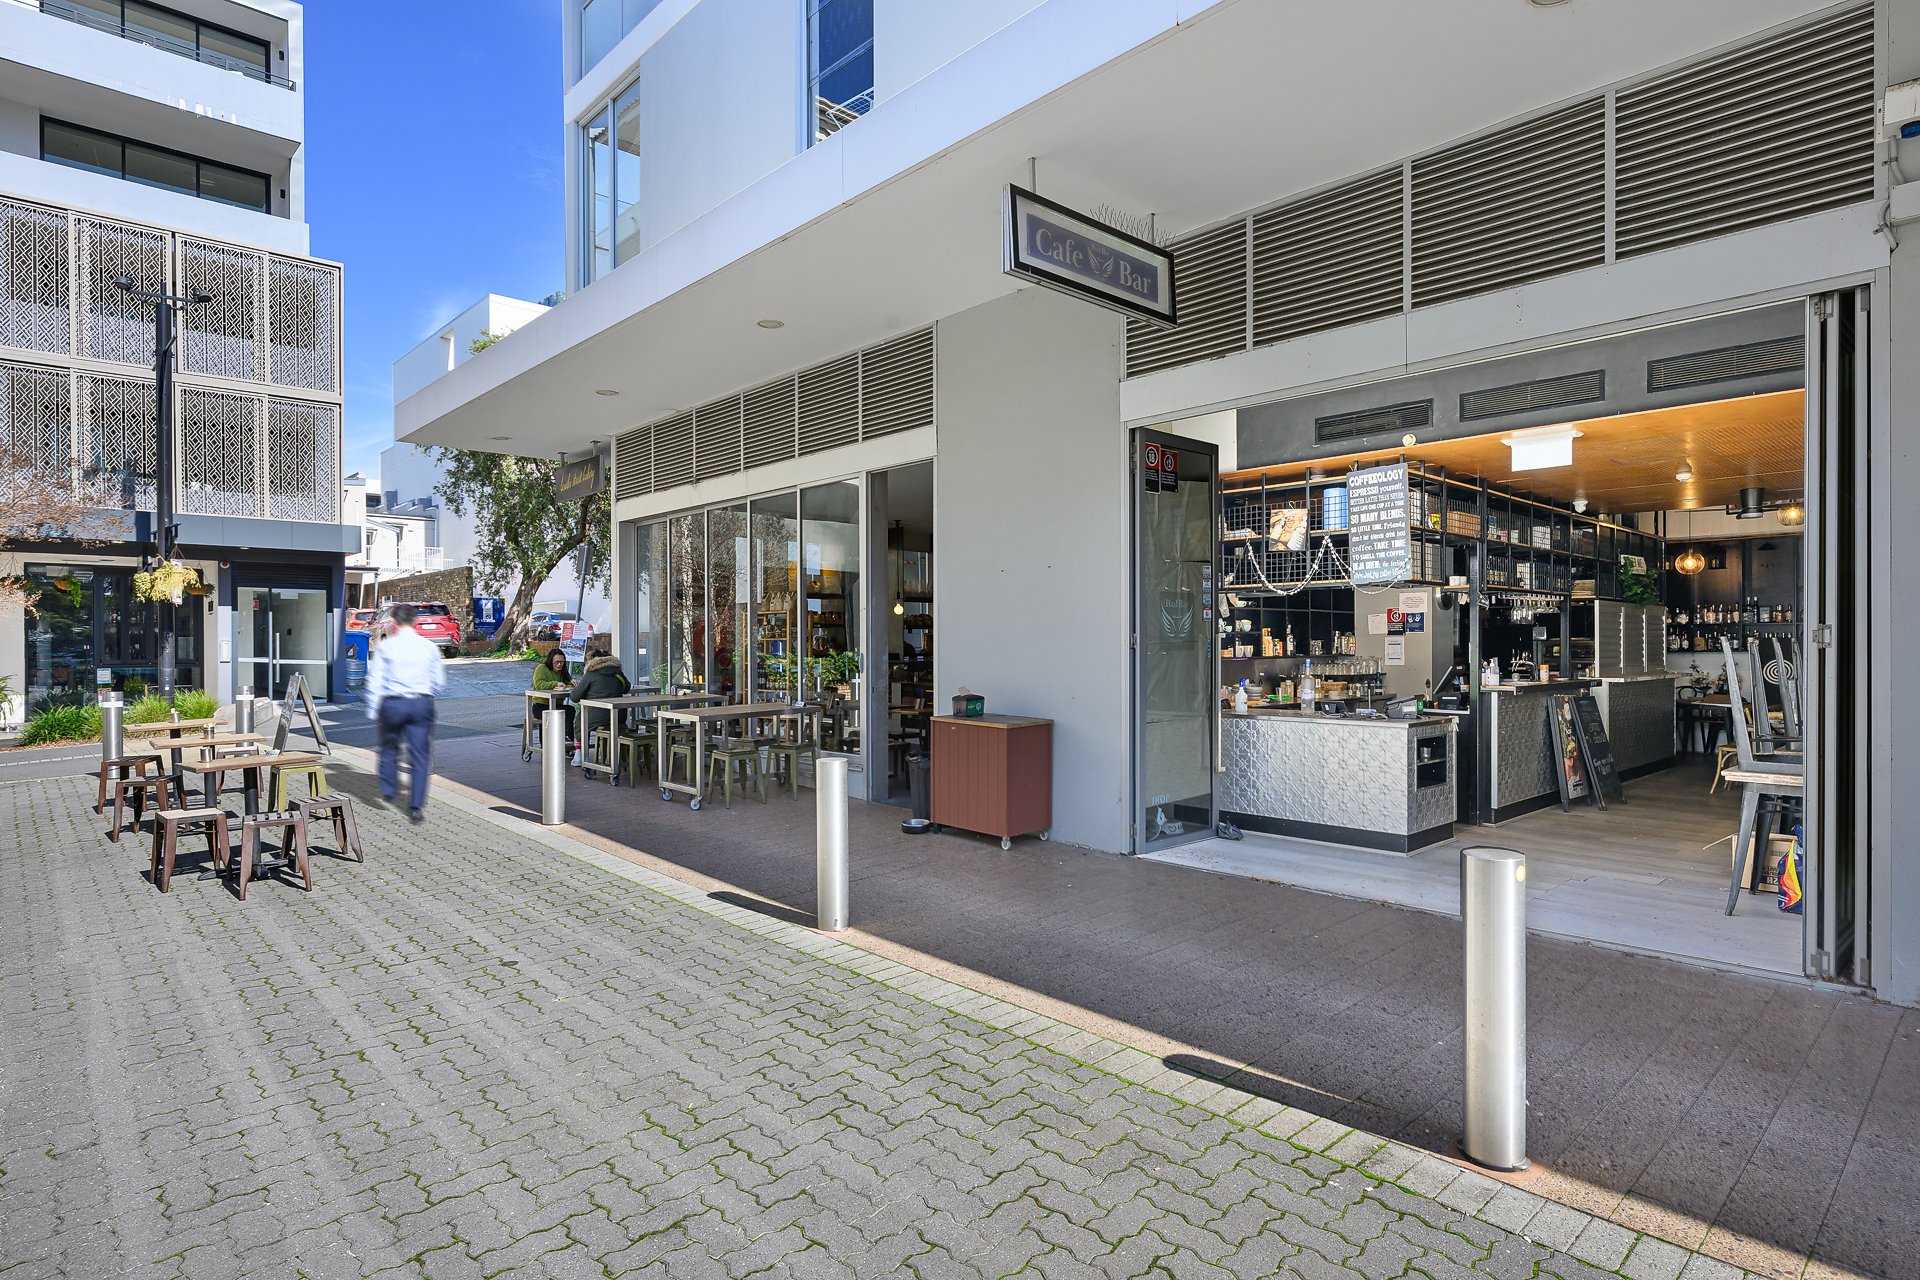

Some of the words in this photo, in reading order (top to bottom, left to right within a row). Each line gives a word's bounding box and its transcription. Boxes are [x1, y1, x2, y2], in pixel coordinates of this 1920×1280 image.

[1036, 228, 1083, 267] Cafe
[1119, 260, 1151, 294] Bar
[1350, 486, 1378, 497] ESPRESSO
[1351, 515, 1358, 524] SO
[1360, 512, 1378, 523] MANY
[1380, 509, 1405, 520] BLENDS.
[1384, 521, 1406, 530] Friends
[1374, 541, 1390, 550] TAKE
